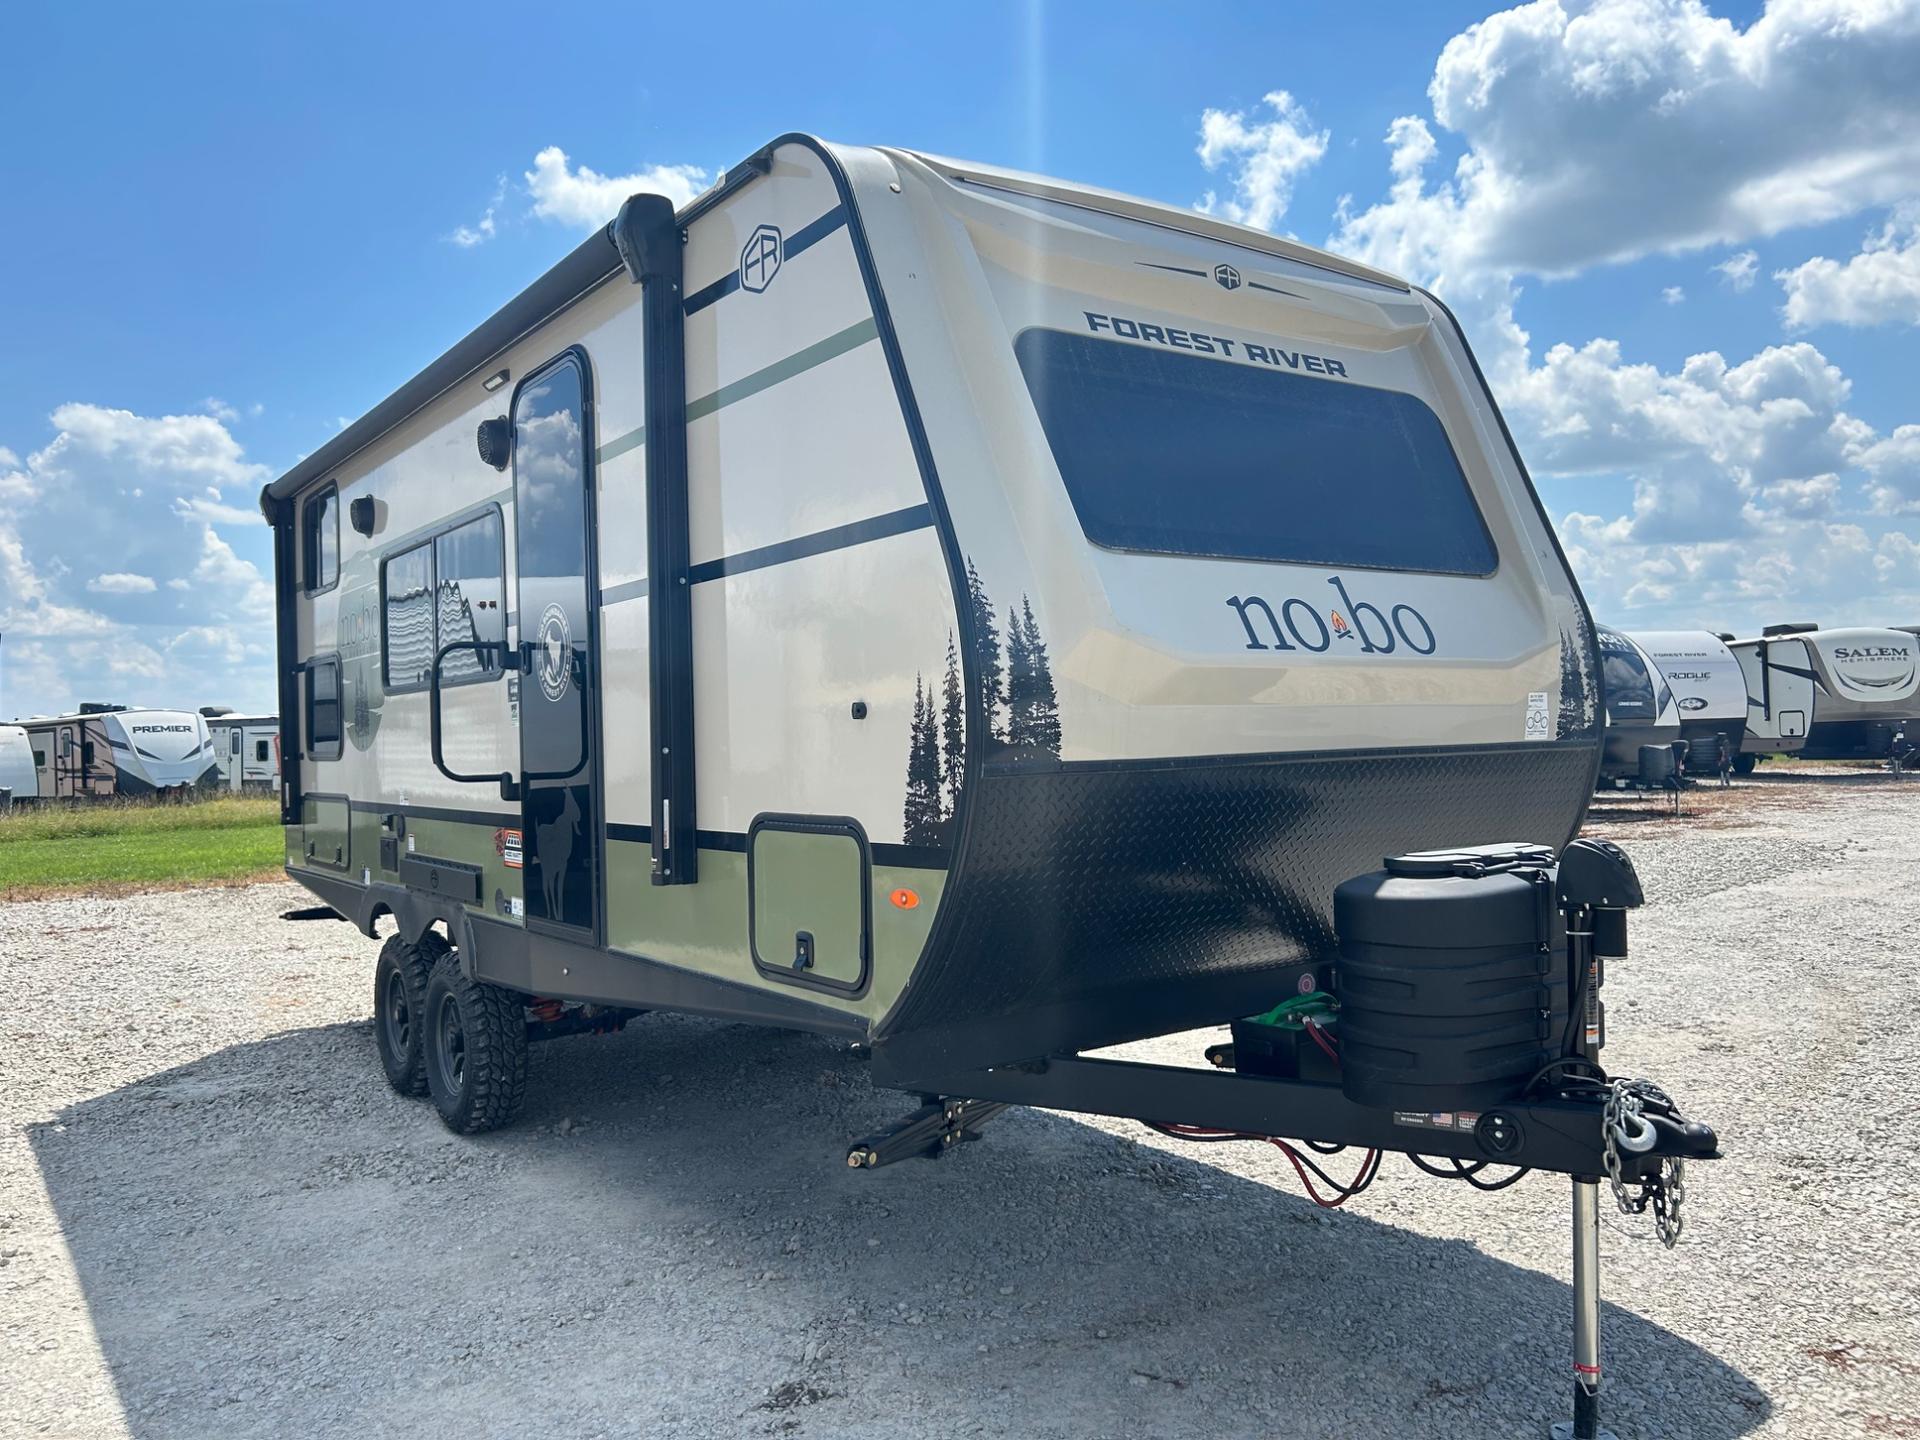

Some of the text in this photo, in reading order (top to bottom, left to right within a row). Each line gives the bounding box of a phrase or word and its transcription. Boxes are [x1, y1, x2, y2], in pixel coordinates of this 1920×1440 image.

[1083, 311, 1348, 378] FOREST RIVER
[1834, 647, 1909, 659] SALEM
[1666, 671, 1711, 680] ROGUE
[132, 725, 192, 733] PREMIER
